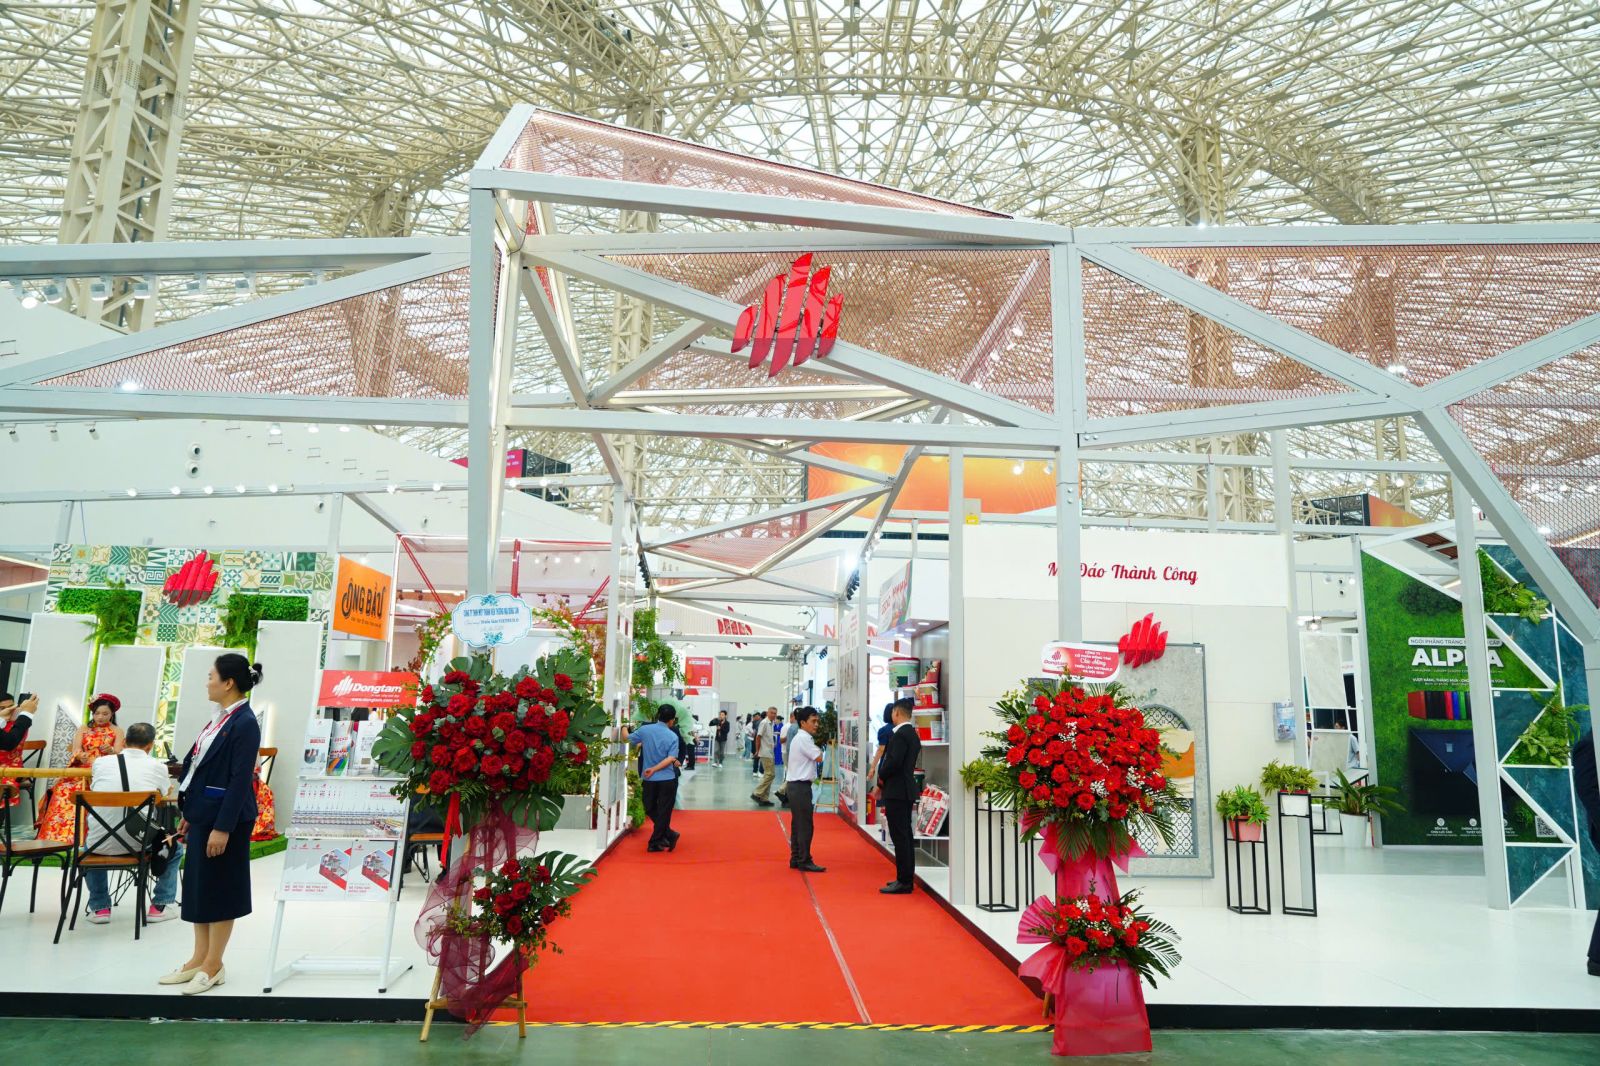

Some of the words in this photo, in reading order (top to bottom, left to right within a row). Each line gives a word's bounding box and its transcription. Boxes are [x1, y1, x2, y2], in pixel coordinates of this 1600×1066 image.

[1048, 562, 1058, 577] M
[1111, 564, 1157, 580] Thành
[1163, 565, 1198, 585] Công
[1411, 647, 1504, 668] ALPA
[352, 683, 402, 694] Dongtam
